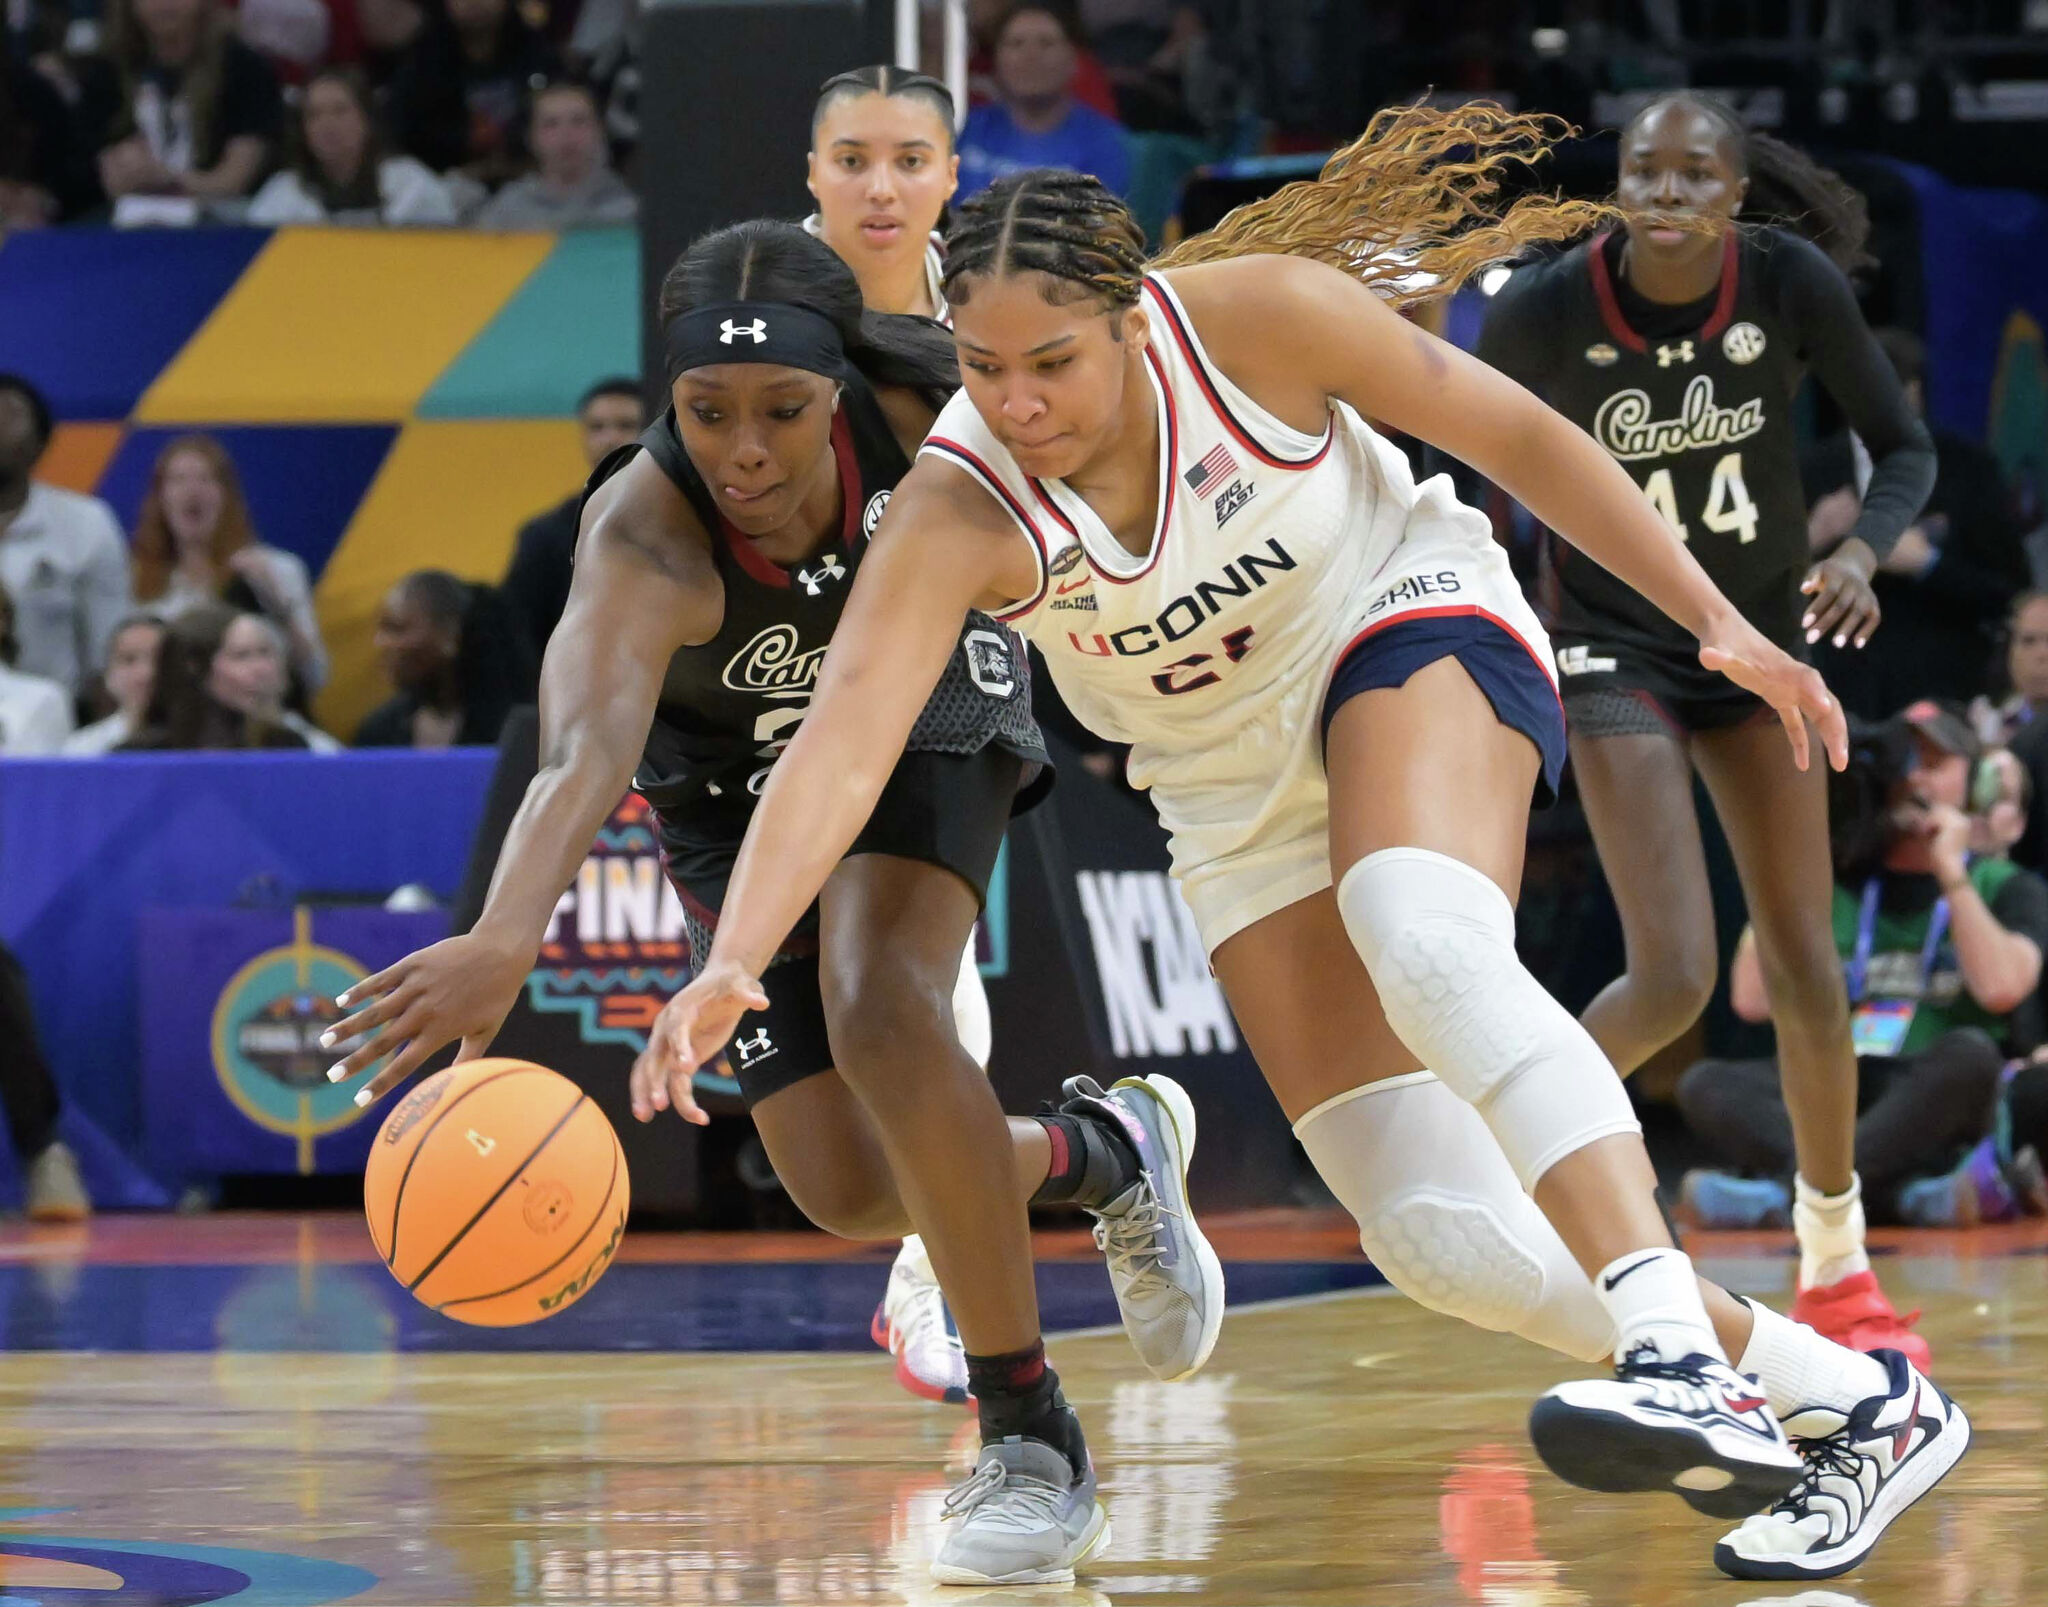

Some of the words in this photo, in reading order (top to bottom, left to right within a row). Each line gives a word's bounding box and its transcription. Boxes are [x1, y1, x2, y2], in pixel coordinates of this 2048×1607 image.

[1594, 374, 1766, 462] Carolina
[1215, 479, 1242, 511] BIG
[1216, 481, 1255, 523] EAST
[1068, 538, 1298, 656] UCONN
[1361, 571, 1461, 620] SKIES
[1077, 870, 1237, 1058] NCAA
